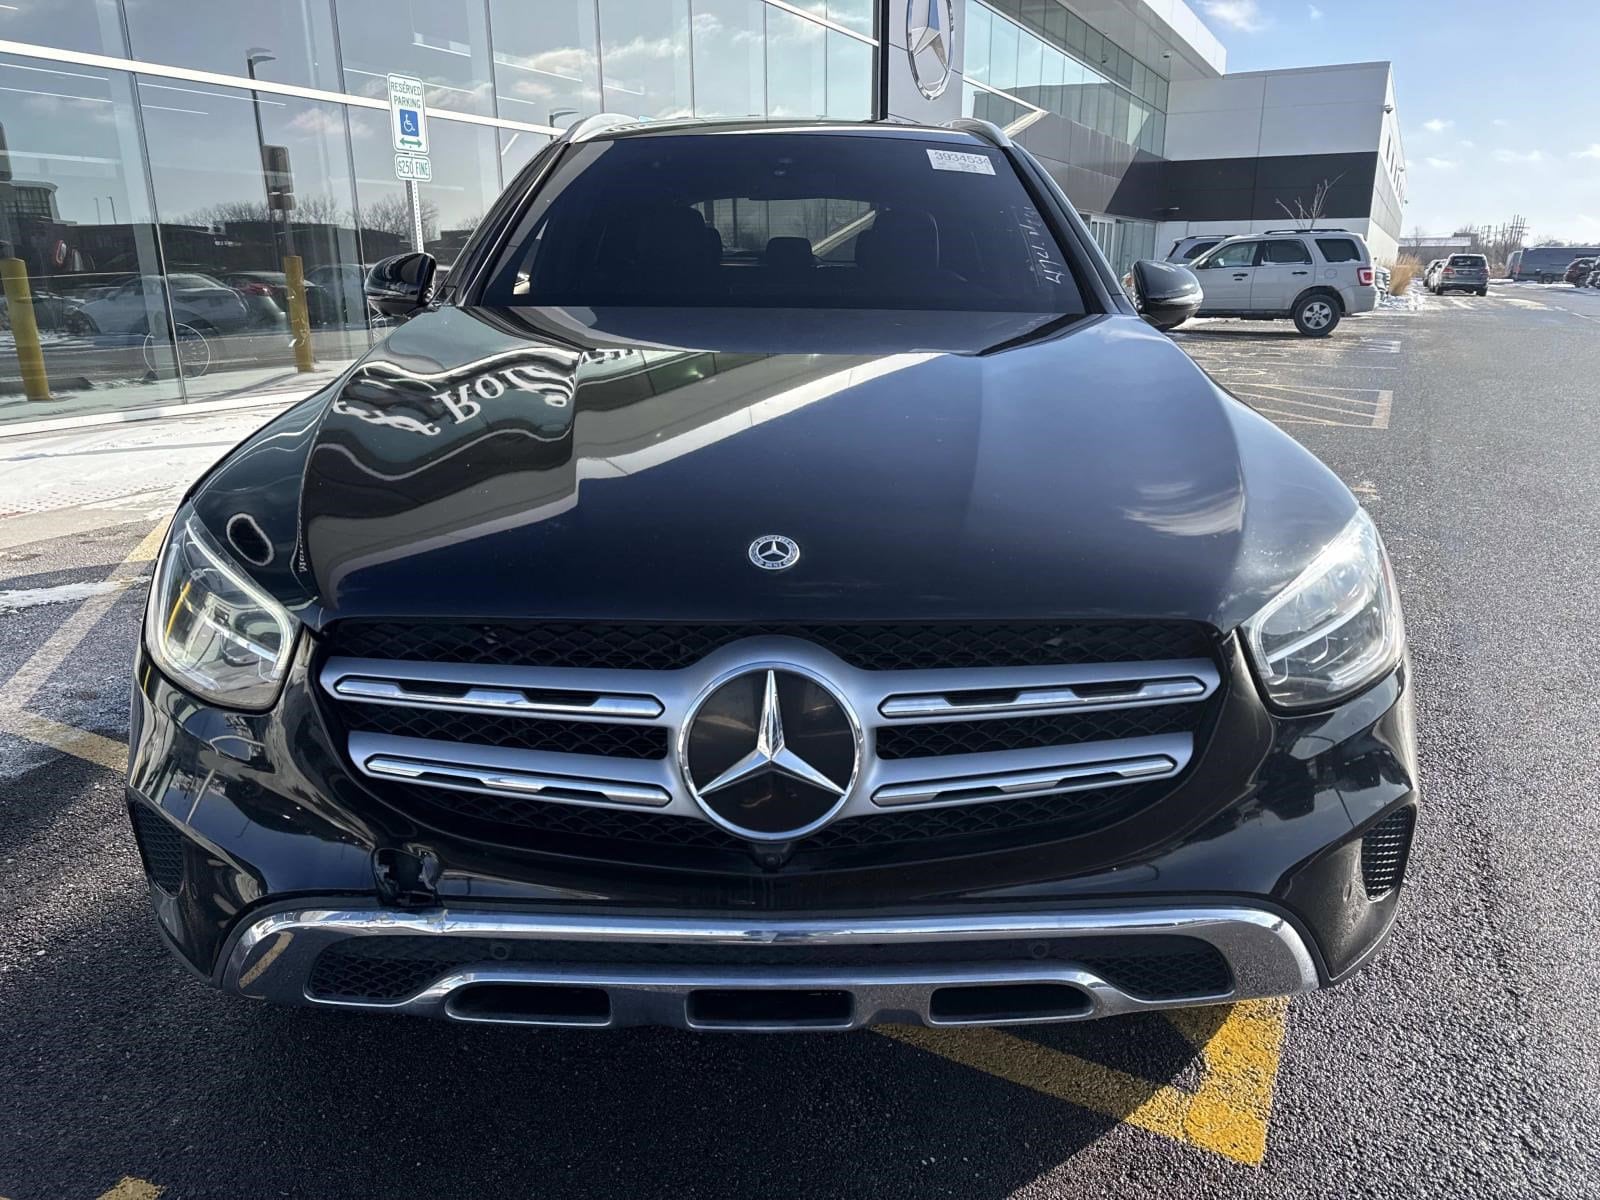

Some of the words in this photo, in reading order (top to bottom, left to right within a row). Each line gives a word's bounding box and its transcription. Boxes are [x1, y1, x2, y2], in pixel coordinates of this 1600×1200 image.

[391, 82, 421, 96] RESERVED
[394, 95, 421, 108] PARKING
[398, 160, 414, 174] $250
[416, 162, 429, 176] FINE
